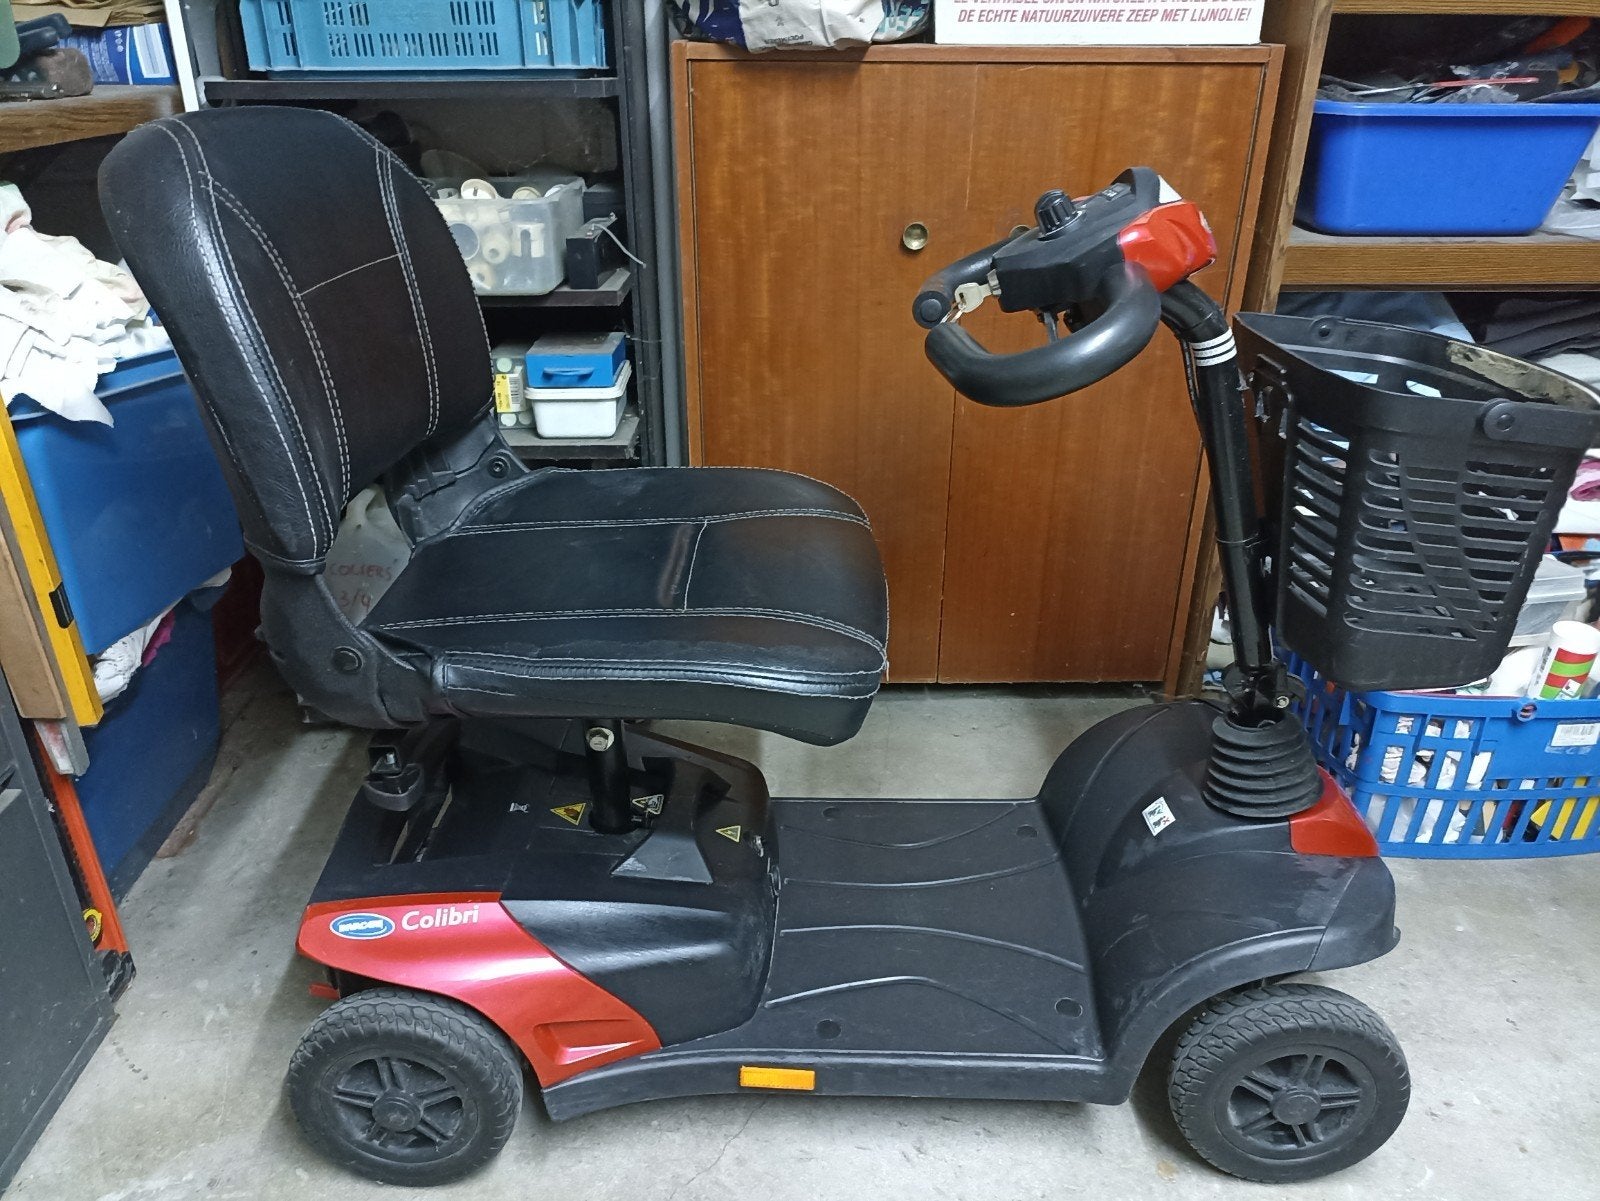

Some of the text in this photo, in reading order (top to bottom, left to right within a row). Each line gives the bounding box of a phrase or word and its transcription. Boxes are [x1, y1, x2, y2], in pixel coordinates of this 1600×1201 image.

[958, 7, 1252, 23] DE ECHTE NATUURZUIVERE ZEEP MET LIJNOLIE!
[401, 905, 479, 931] Colibri
